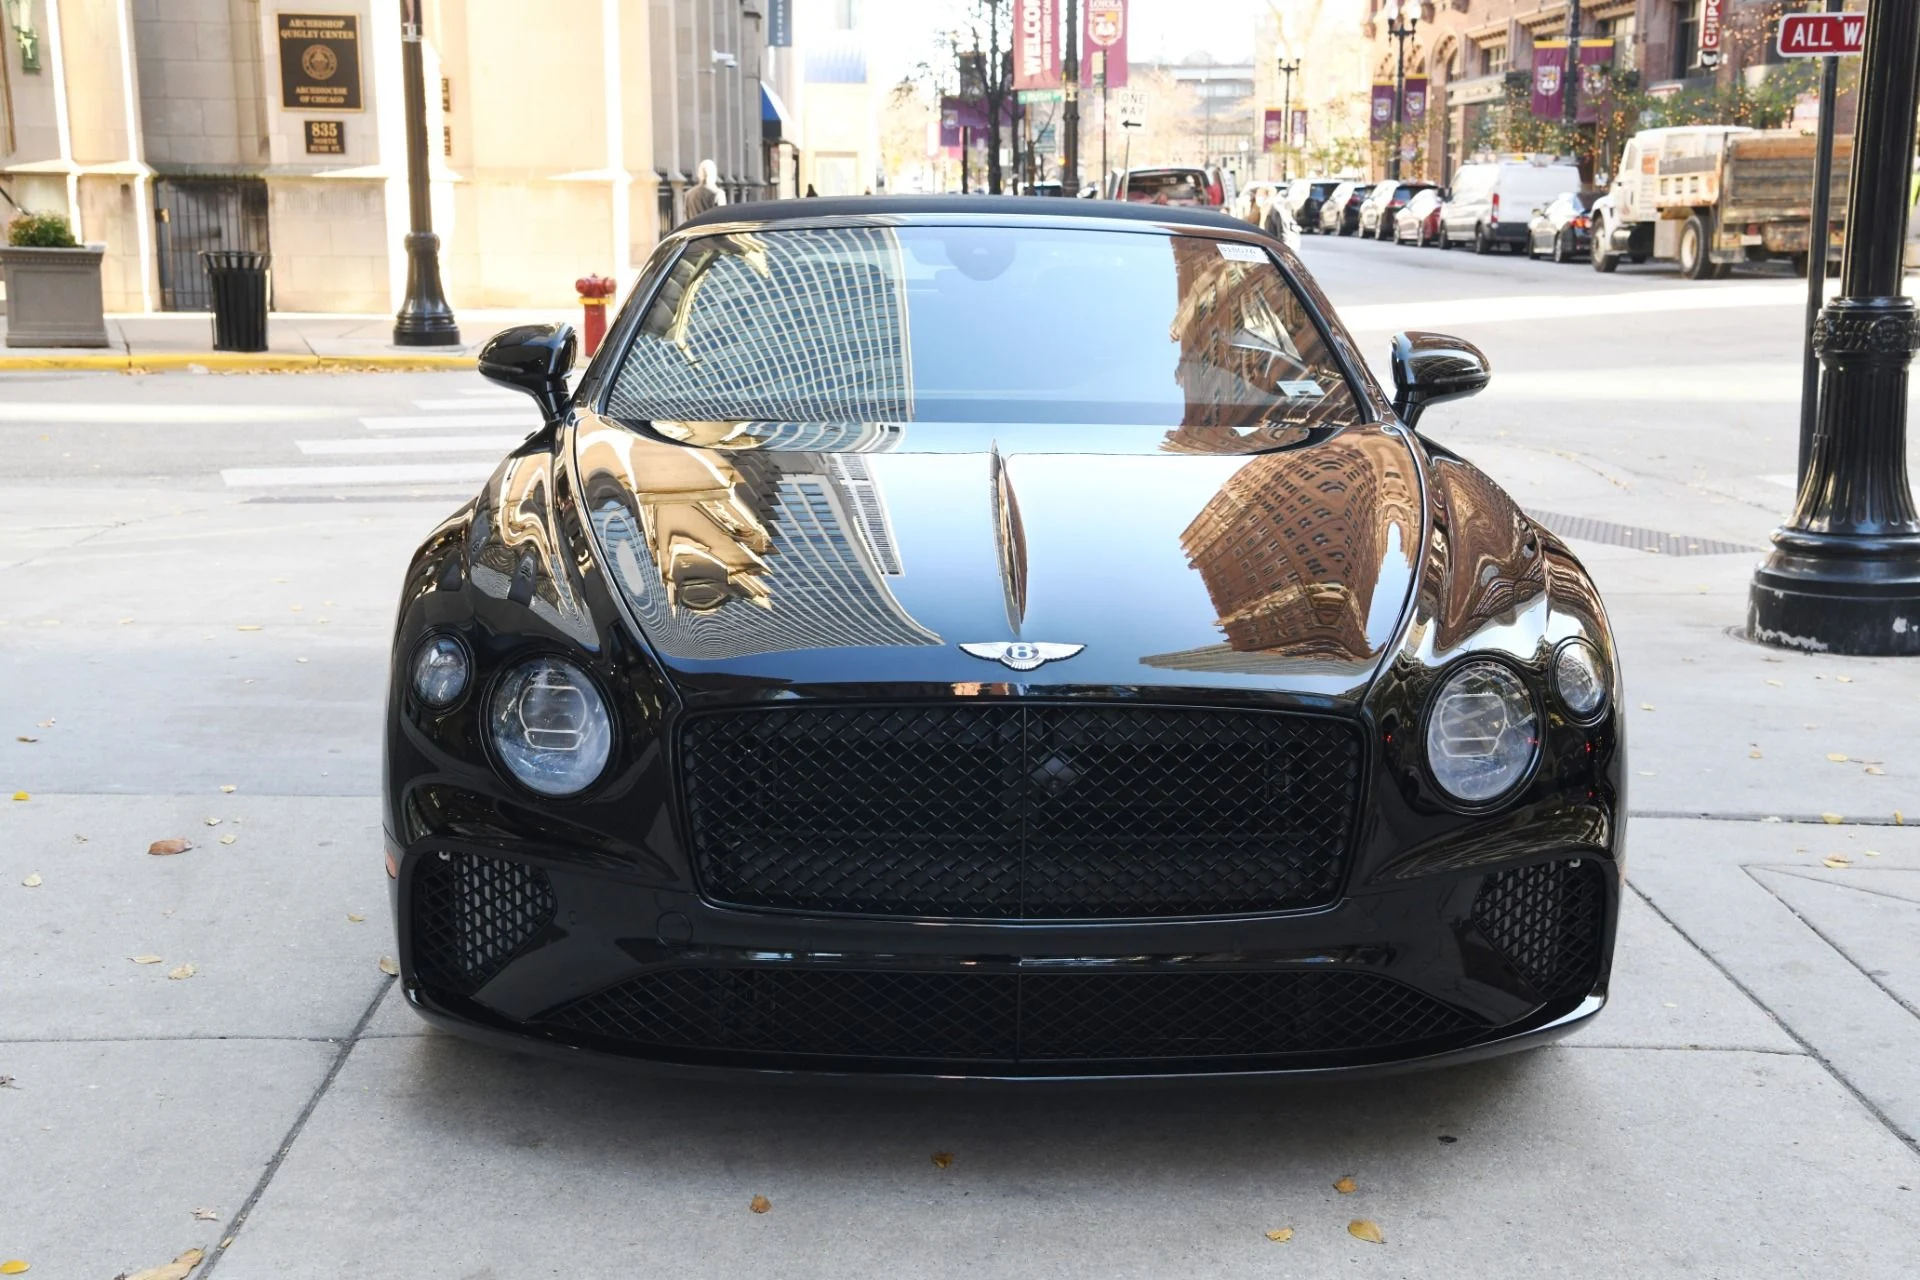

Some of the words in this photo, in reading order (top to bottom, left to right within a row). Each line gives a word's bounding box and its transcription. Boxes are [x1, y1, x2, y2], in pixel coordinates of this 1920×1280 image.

[289, 19, 345, 28] ARCHBISHOP
[280, 29, 319, 39] QUIGLEY
[320, 30, 355, 39] CENTER
[1791, 23, 1833, 47] ALL
[1843, 22, 1866, 46] W
[310, 96, 345, 104] CHICAGO
[1121, 92, 1145, 104] ONE
[1120, 105, 1145, 116] WAY
[311, 122, 338, 137] 835
[1010, 644, 1034, 660] B
